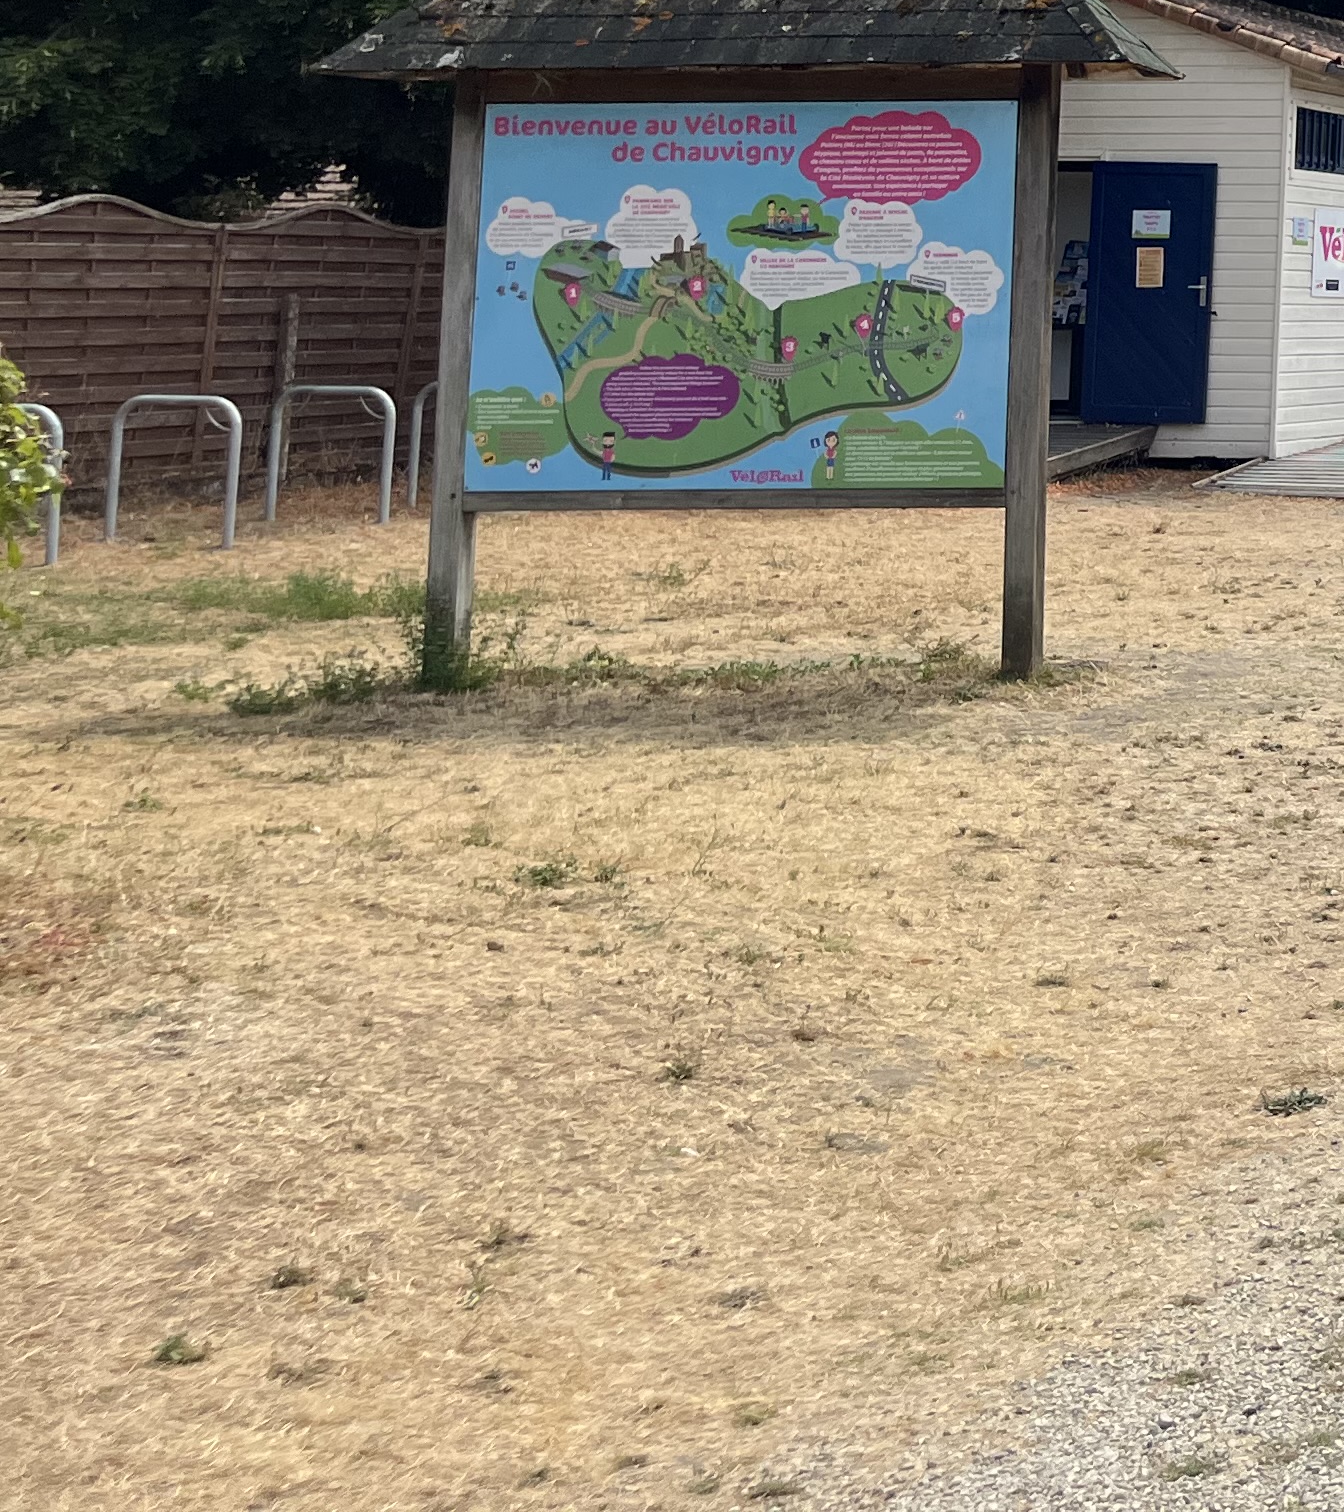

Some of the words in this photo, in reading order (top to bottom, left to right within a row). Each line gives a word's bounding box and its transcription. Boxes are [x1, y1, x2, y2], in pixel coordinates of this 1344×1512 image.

[493, 115, 638, 136] Bienvenue
[644, 117, 678, 136] au
[683, 112, 798, 136] VéloRail
[611, 140, 646, 163] de
[651, 140, 797, 166] Chauvigny
[693, 281, 702, 292] 2
[569, 288, 577, 298] 1
[860, 319, 870, 330] 4
[785, 341, 794, 352] 3
